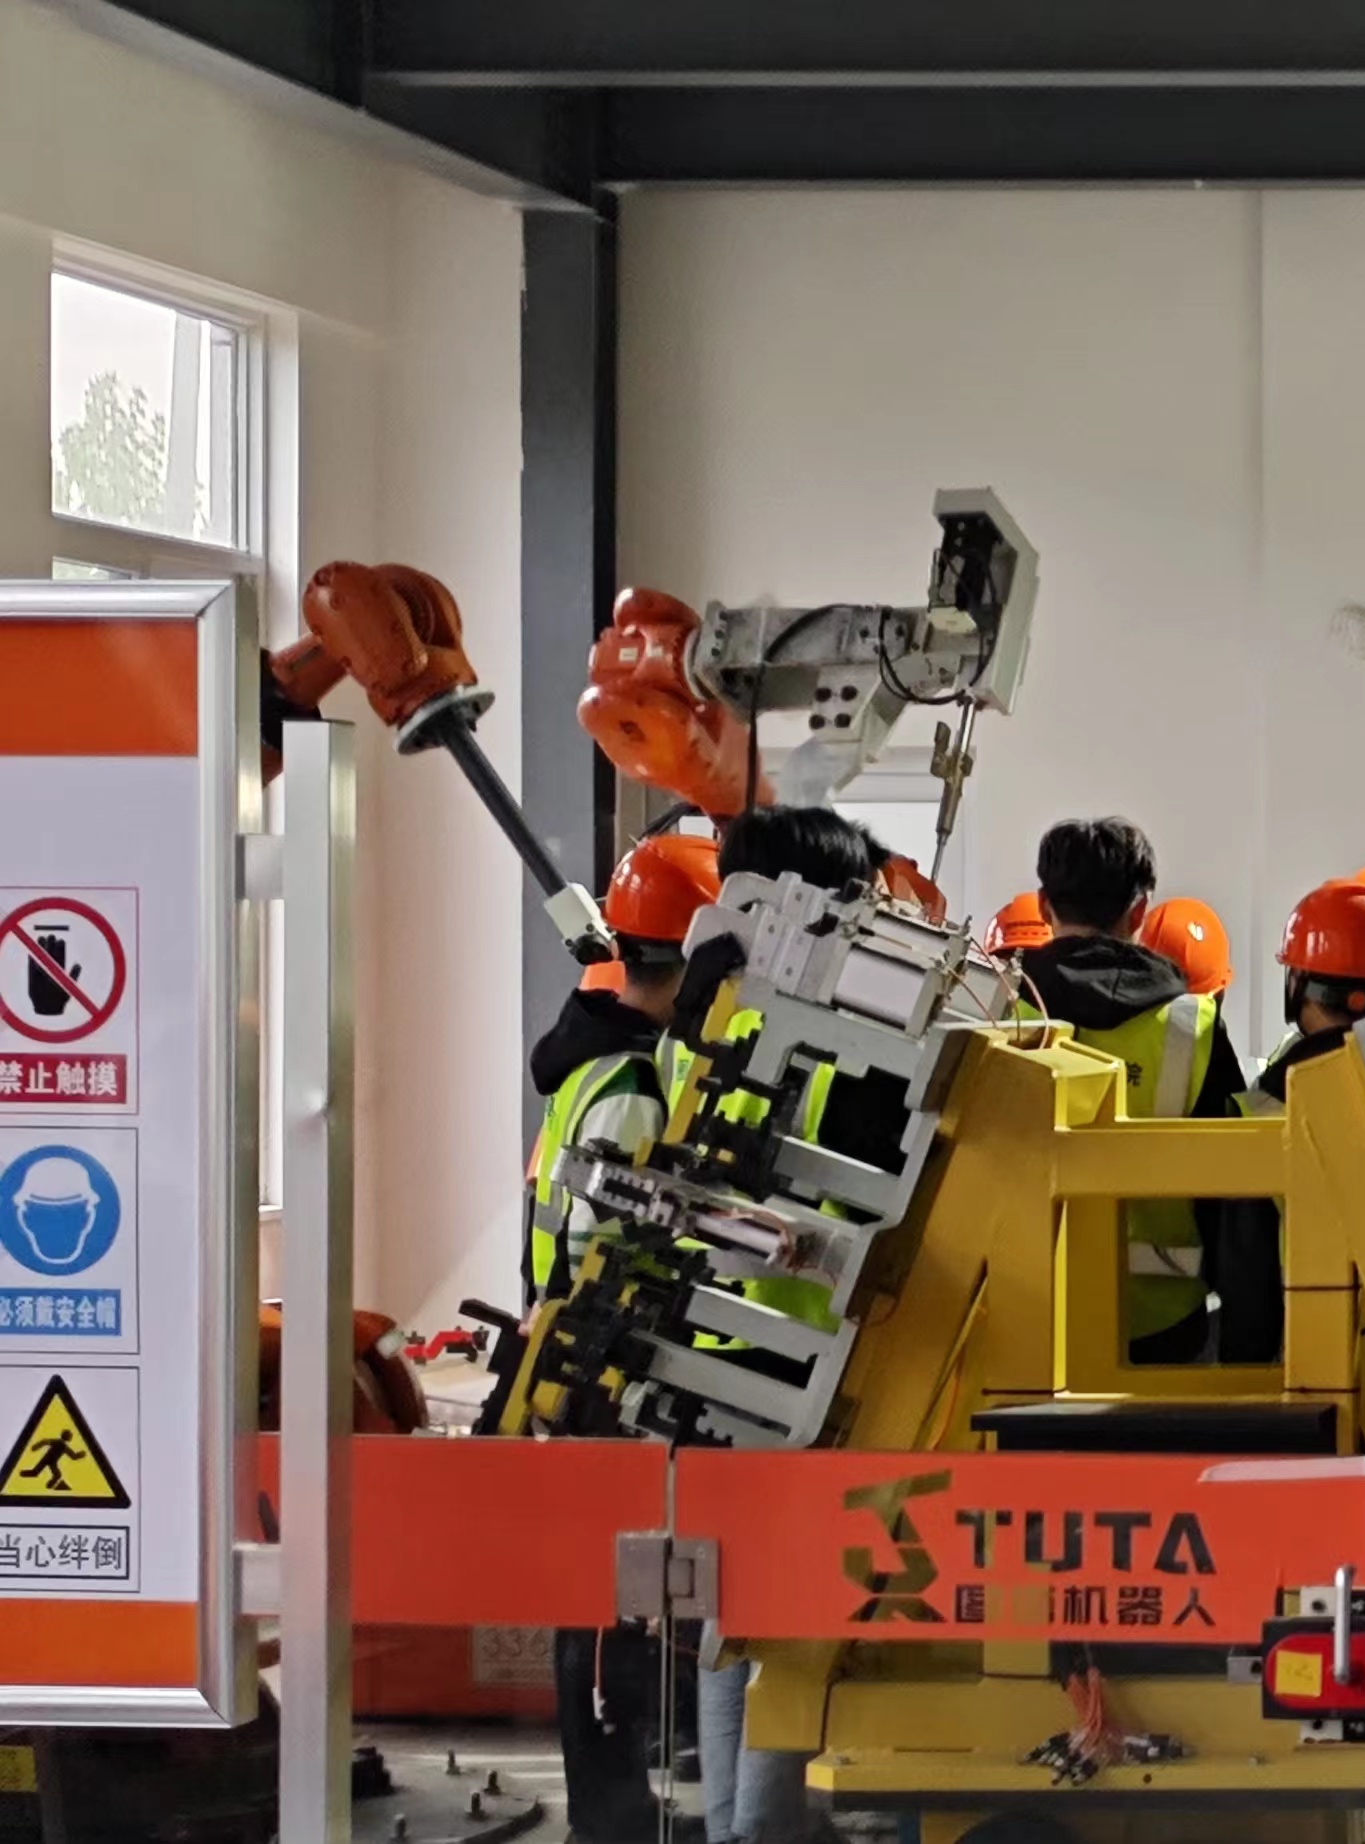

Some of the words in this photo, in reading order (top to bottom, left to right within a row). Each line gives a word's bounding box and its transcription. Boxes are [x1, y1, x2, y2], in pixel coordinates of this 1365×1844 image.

[0, 1060, 117, 1096] 禁止触摸
[0, 1533, 122, 1570] 当心绊倒
[955, 1509, 1217, 1574] TUTA
